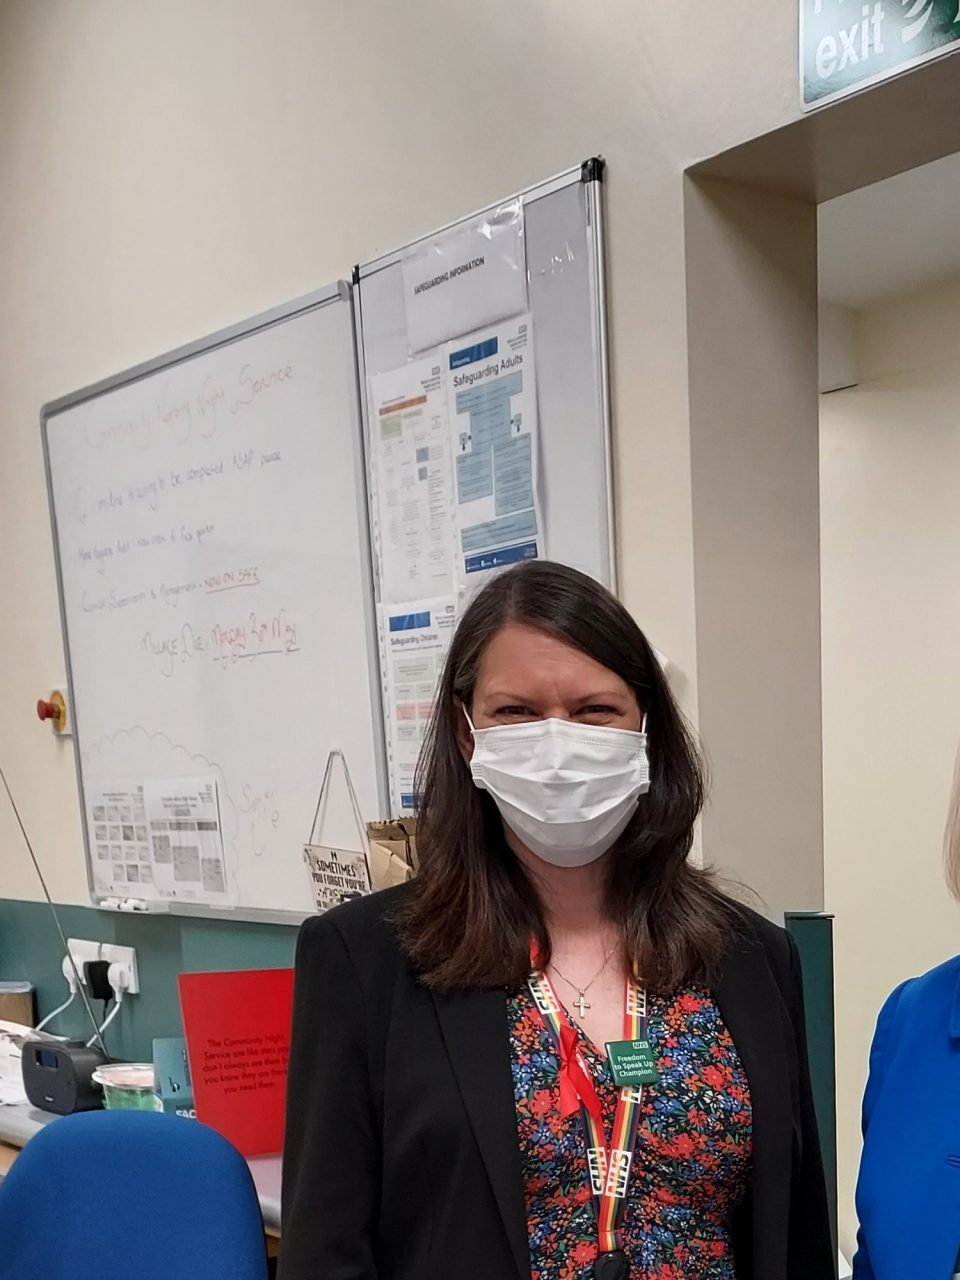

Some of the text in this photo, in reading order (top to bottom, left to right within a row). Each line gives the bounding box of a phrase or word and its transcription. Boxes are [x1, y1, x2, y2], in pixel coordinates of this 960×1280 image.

[815, 2, 885, 79] exit
[449, 256, 485, 279] INFORMATION
[453, 364, 499, 388] Safeguarding
[500, 354, 523, 371] Adults
[316, 859, 356, 878] SOMETIMES
[312, 872, 324, 884] YOU
[323, 874, 345, 888] FORGET
[223, 1036, 263, 1047] Community
[633, 1041, 648, 1049] NHS
[203, 1051, 231, 1060] Service
[617, 1054, 647, 1062] Freedom
[224, 1061, 250, 1071] always
[622, 1061, 643, 1070] Speak
[220, 1072, 240, 1083] know
[619, 1069, 653, 1077] Champion
[224, 1087, 238, 1095] you
[239, 1082, 257, 1091] need
[607, 1151, 629, 1197] NHS
